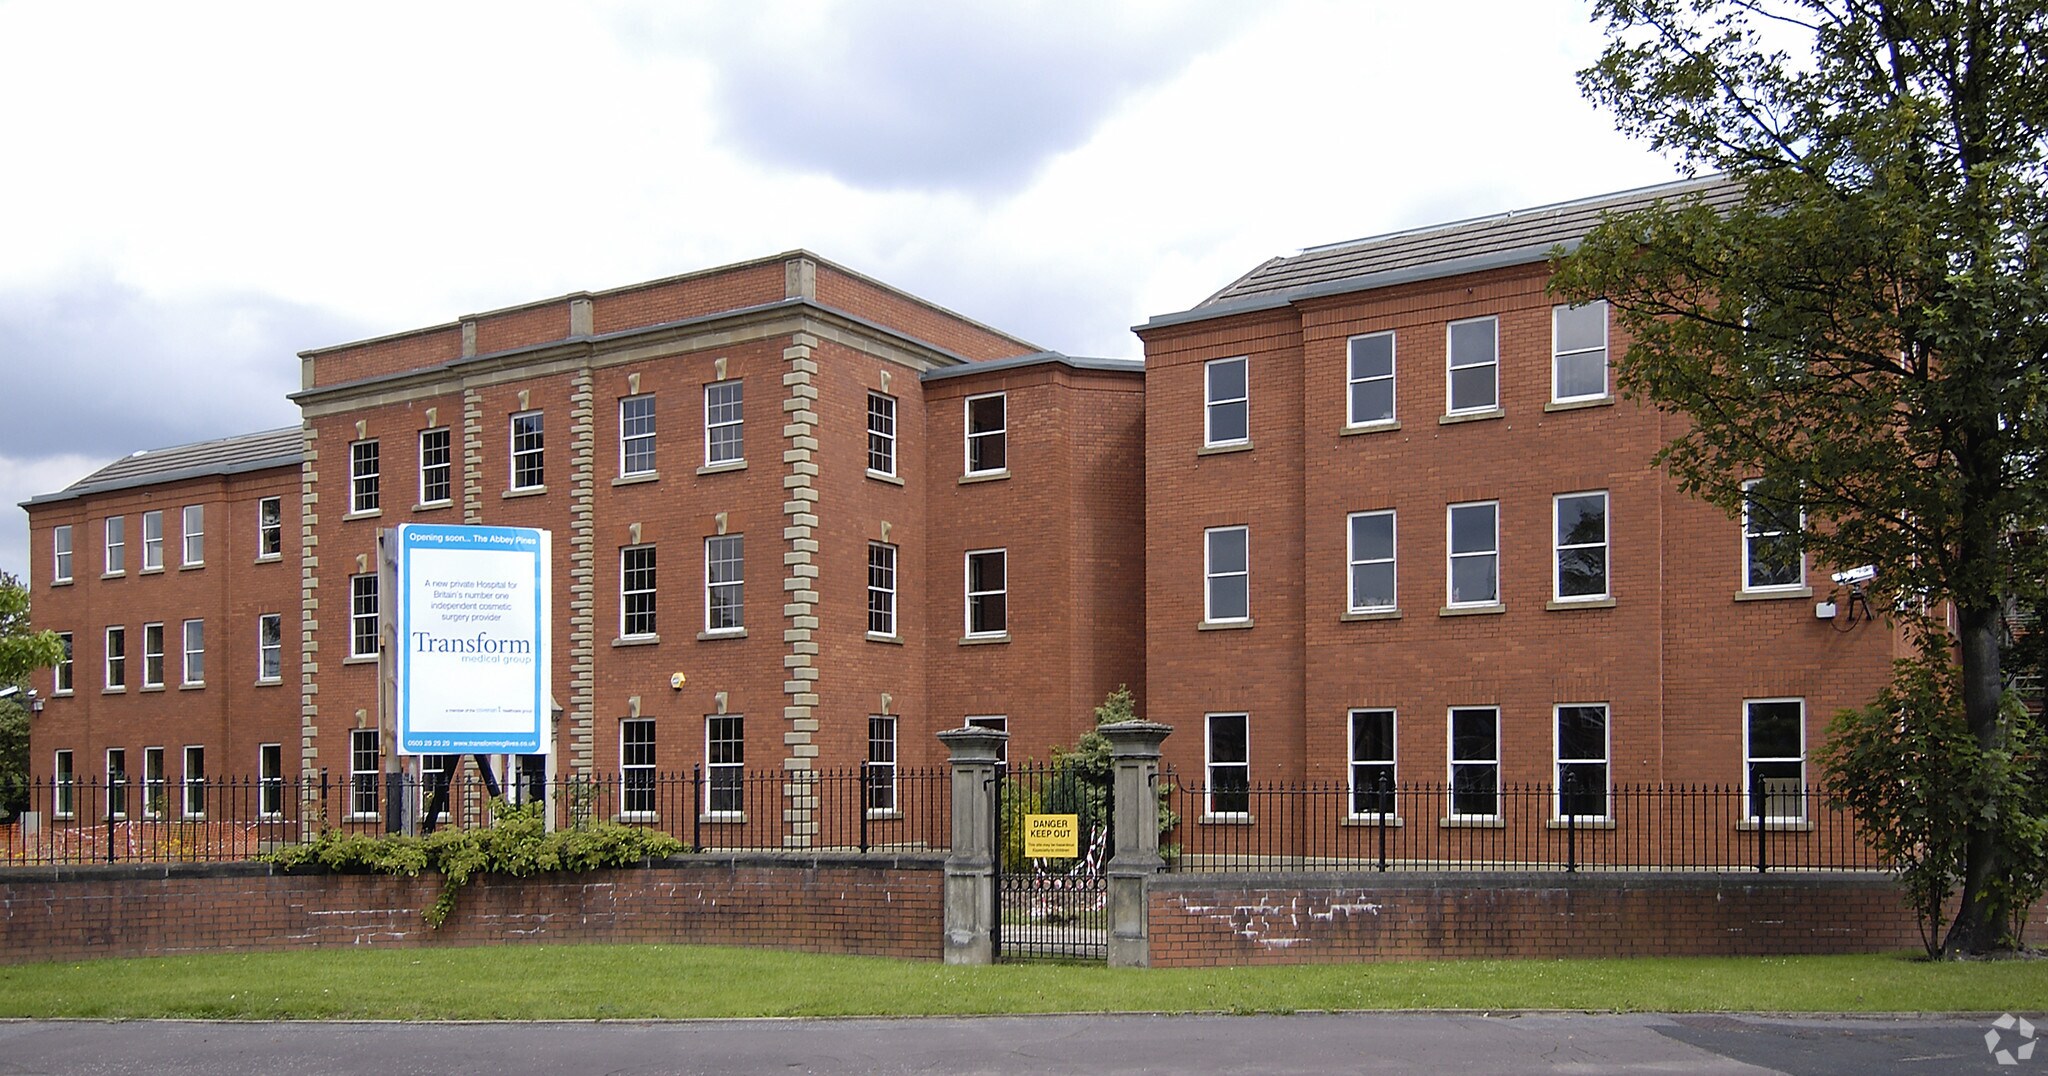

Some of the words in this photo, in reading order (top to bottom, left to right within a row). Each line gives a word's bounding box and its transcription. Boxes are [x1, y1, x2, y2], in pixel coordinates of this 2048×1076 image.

[409, 532, 443, 544] Opening
[445, 534, 471, 542] soon...
[473, 534, 488, 542] The
[490, 535, 514, 545] Abbey
[516, 536, 536, 545] Pines
[450, 580, 474, 589] private
[477, 580, 506, 590] Hospital
[508, 580, 518, 588] for
[431, 602, 478, 611] independent
[478, 602, 512, 610] cosmetic
[442, 614, 470, 622] surgery
[472, 613, 501, 622] provider
[412, 631, 531, 654] Transform
[462, 654, 500, 663] medical
[503, 656, 532, 664] group
[453, 740, 536, 748] www.transforminglives.co.uk
[1033, 820, 1068, 828] DANGER
[1030, 830, 1052, 838] KEEP
[1053, 830, 1071, 838] OUT
